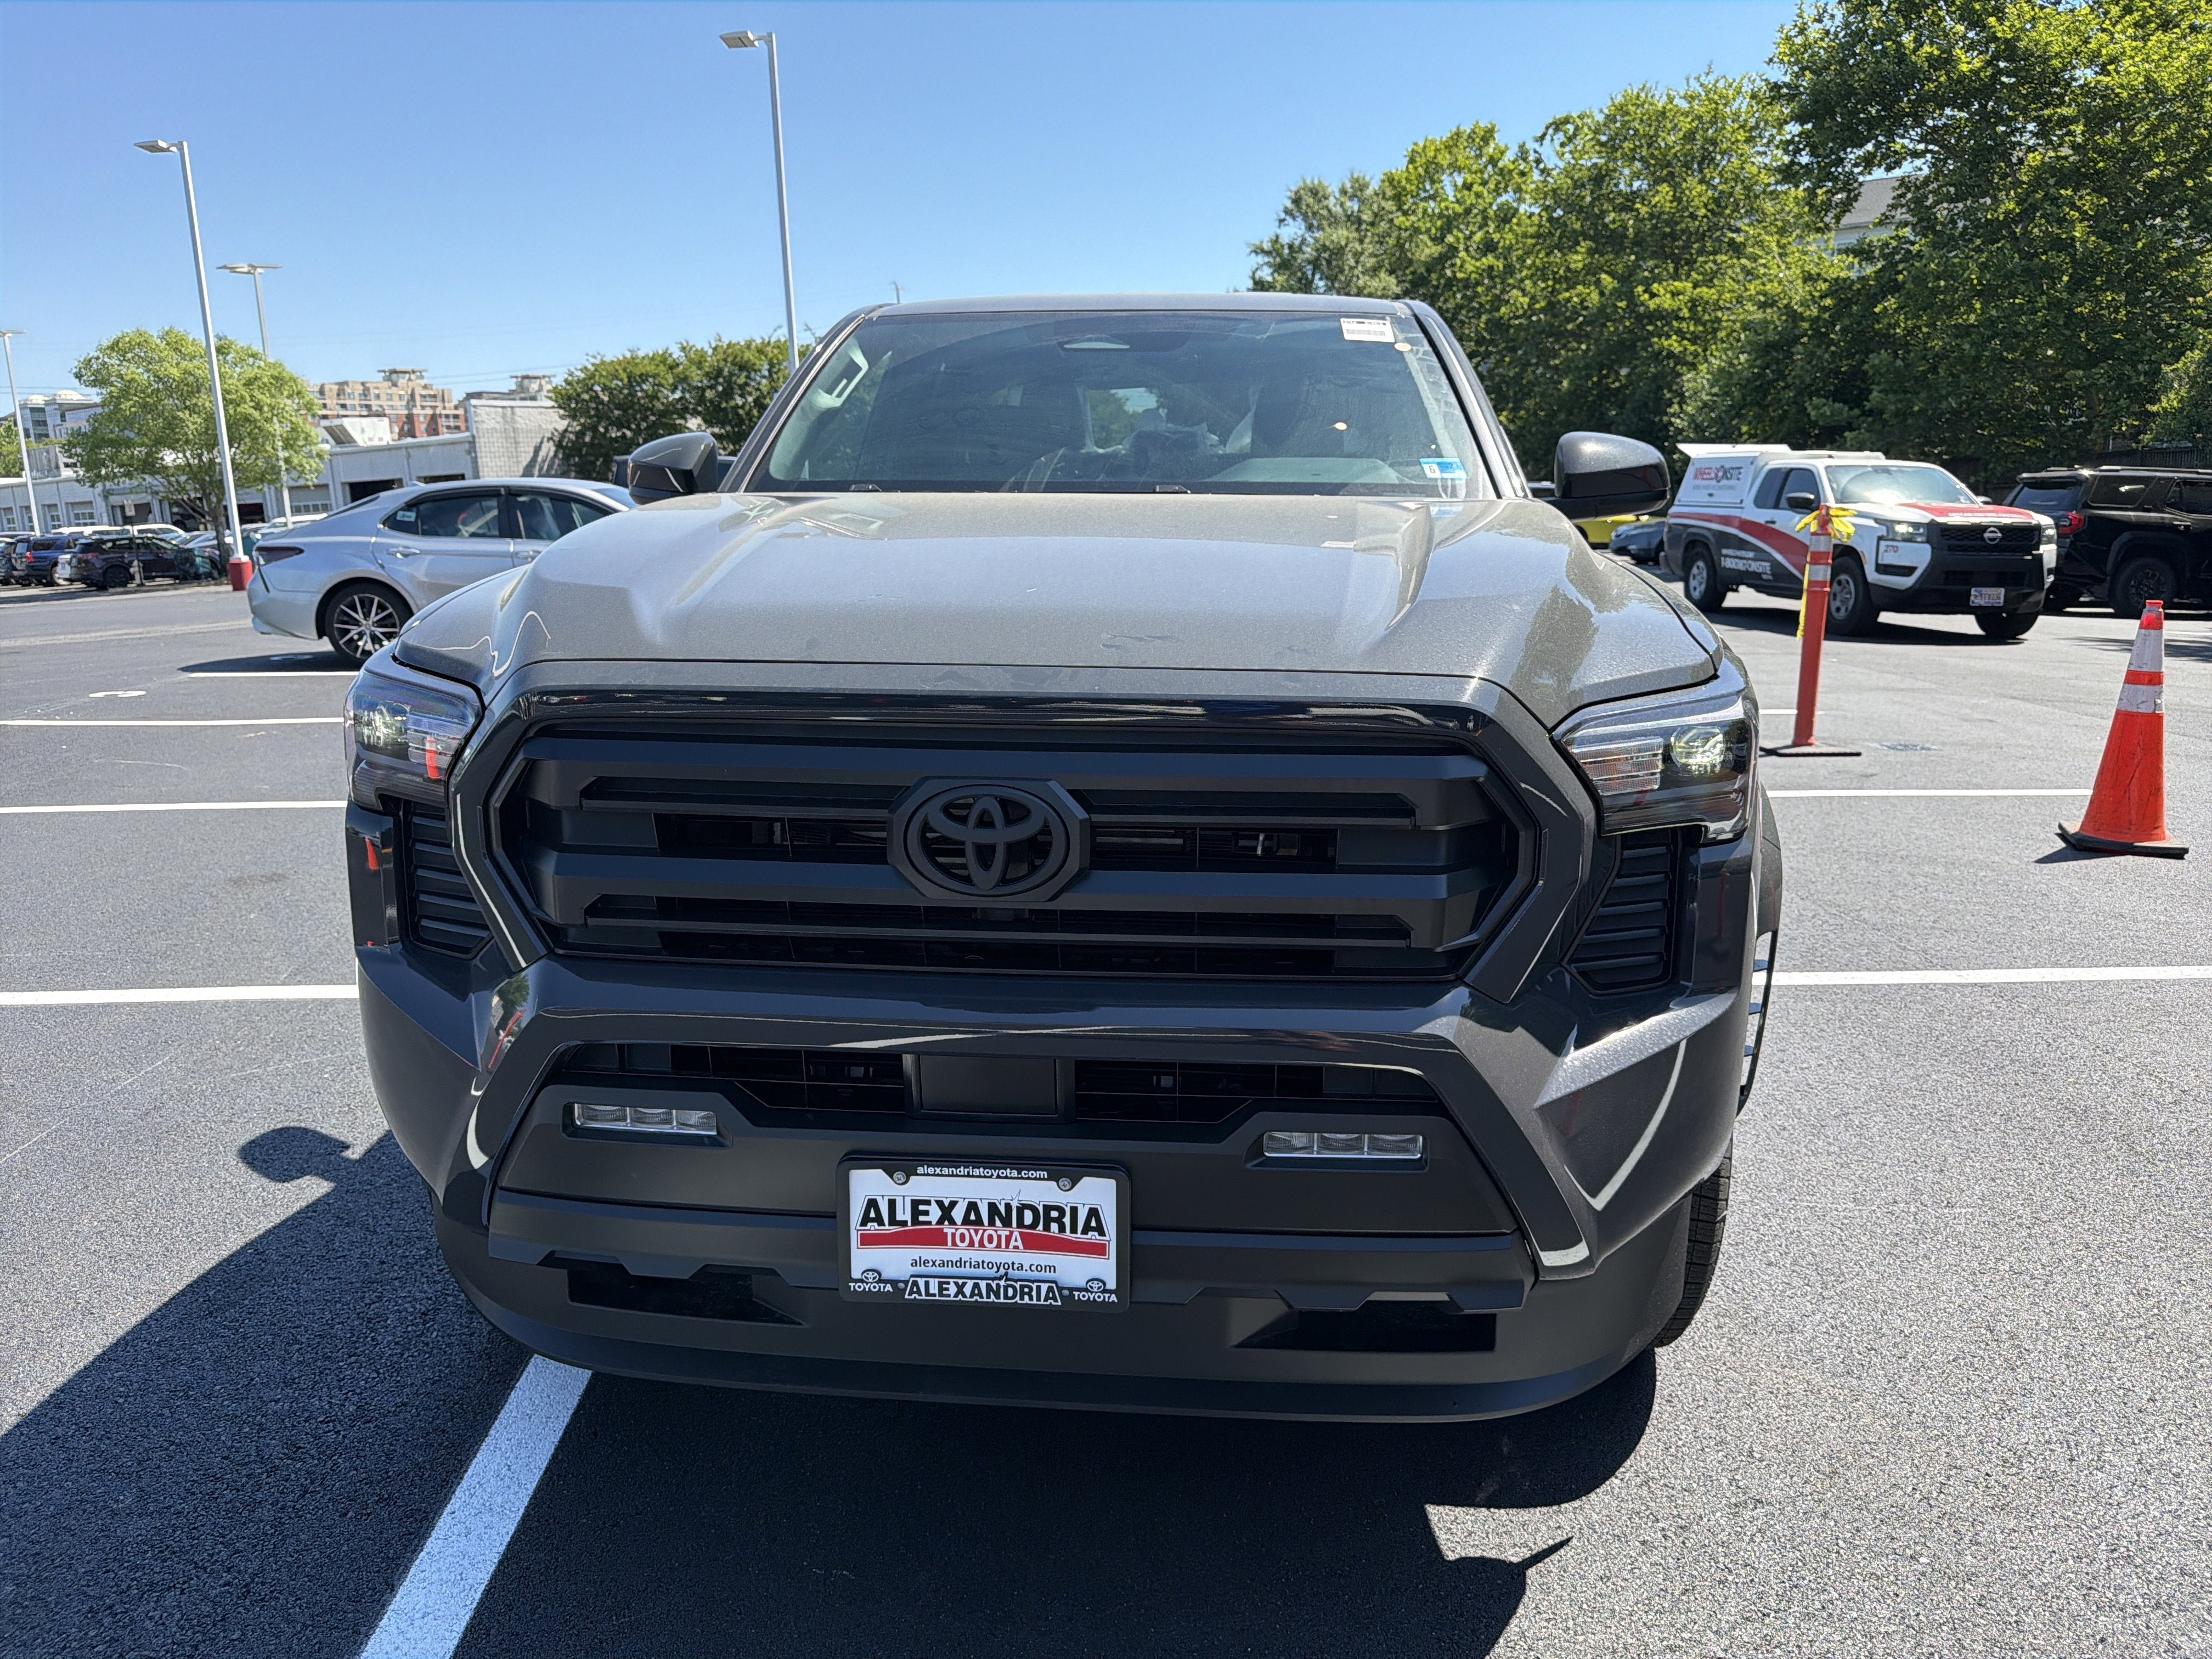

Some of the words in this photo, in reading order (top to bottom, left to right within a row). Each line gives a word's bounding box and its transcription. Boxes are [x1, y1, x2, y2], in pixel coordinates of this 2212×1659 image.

[917, 1165, 1048, 1179] alexandriatoyota.com
[858, 1197, 1107, 1238] ALEXANDRIA
[943, 1228, 1024, 1250] TOYOTA
[910, 1256, 1057, 1274] alexandriatoyota.com
[849, 1283, 893, 1292] TOYOTA
[905, 1277, 1062, 1305] ALEXANDRIA
[1073, 1291, 1118, 1303] TOYOTA
